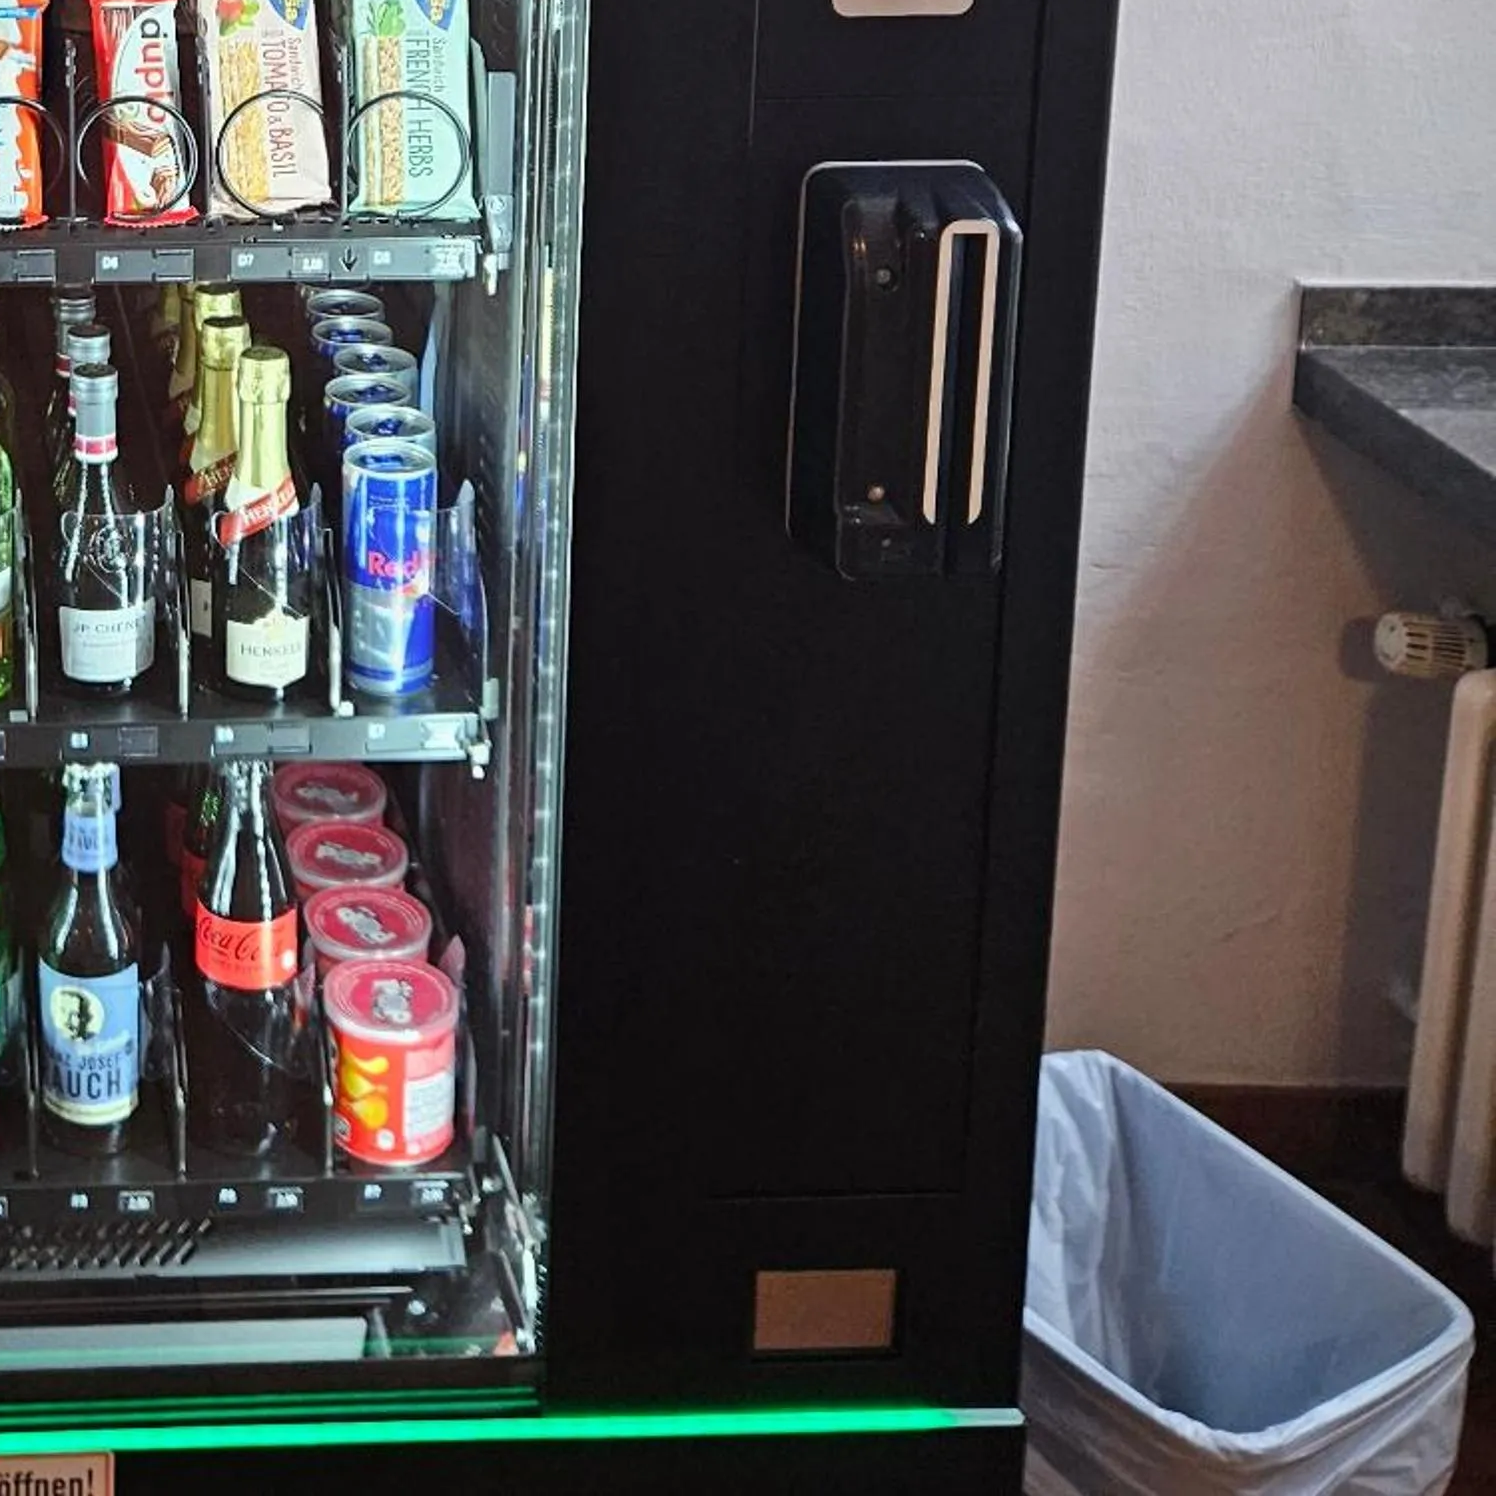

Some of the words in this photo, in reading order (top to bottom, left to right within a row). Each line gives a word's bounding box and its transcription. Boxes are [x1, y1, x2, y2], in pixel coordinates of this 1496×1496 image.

[134, 18, 175, 126] duplo
[267, 127, 299, 179] BASIL
[406, 118, 434, 179] HERBS
[368, 550, 423, 580] Red
[50, 1068, 122, 1099] AUCH
